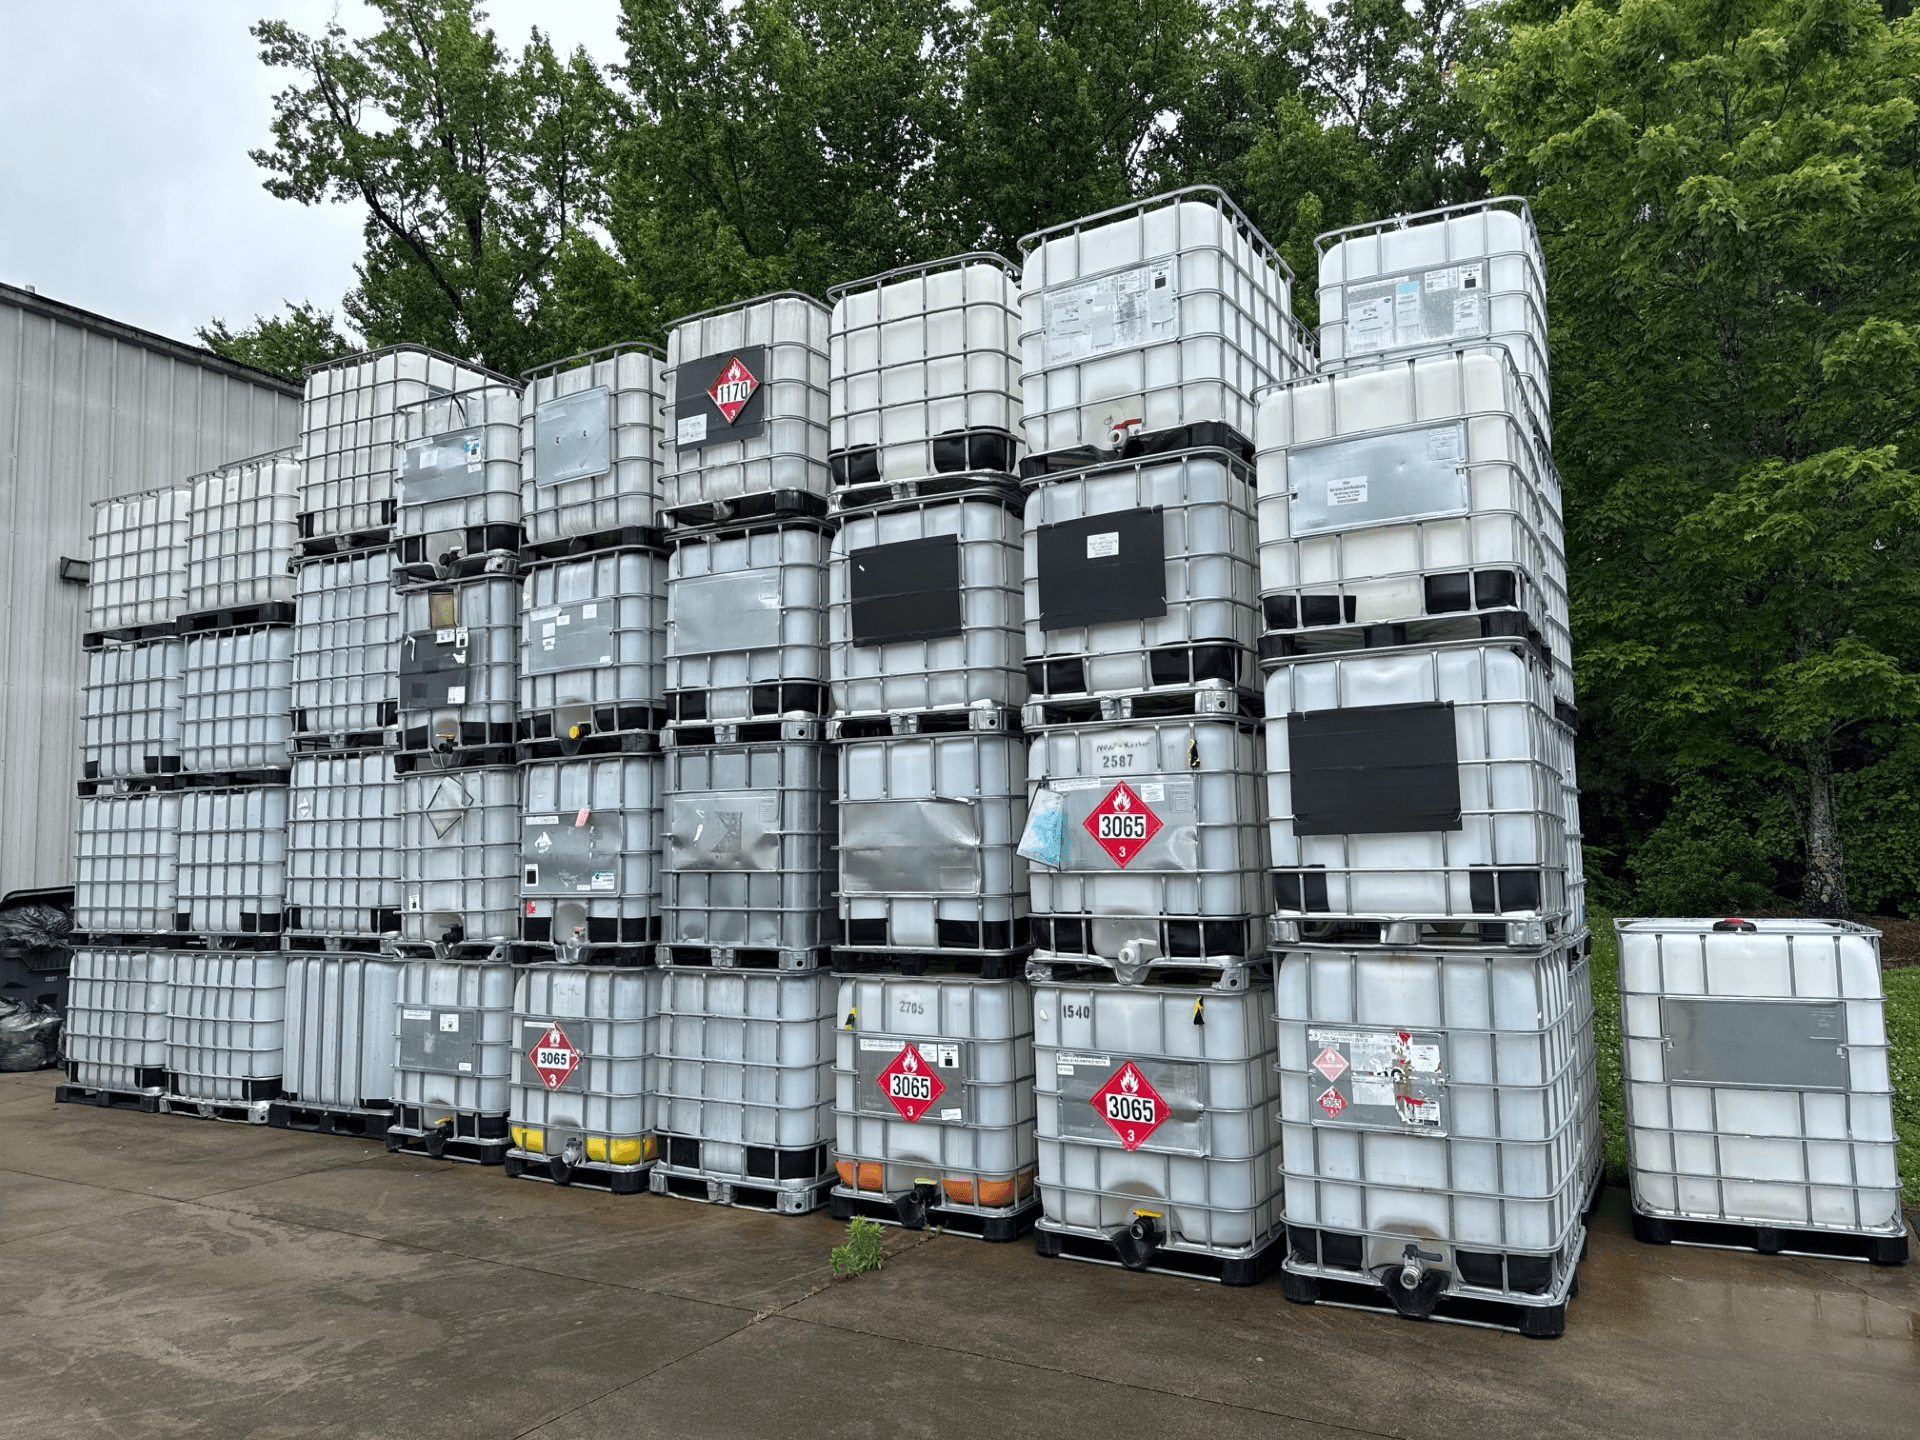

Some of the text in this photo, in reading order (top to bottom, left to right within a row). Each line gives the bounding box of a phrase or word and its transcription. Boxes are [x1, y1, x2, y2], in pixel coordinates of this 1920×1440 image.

[720, 382, 748, 402] 1170
[1103, 754, 1133, 768] 2587
[1102, 815, 1144, 837] 3065
[1119, 847, 1126, 857] 3
[900, 1000, 924, 1015] 2705
[1063, 1005, 1090, 1019] 1540
[540, 1052, 567, 1065] 3065
[549, 1074, 557, 1086] 3
[892, 1075, 930, 1099] 3065
[907, 1106, 914, 1116] 3
[1108, 1096, 1154, 1122] 3065
[1127, 1129, 1135, 1142] 3
